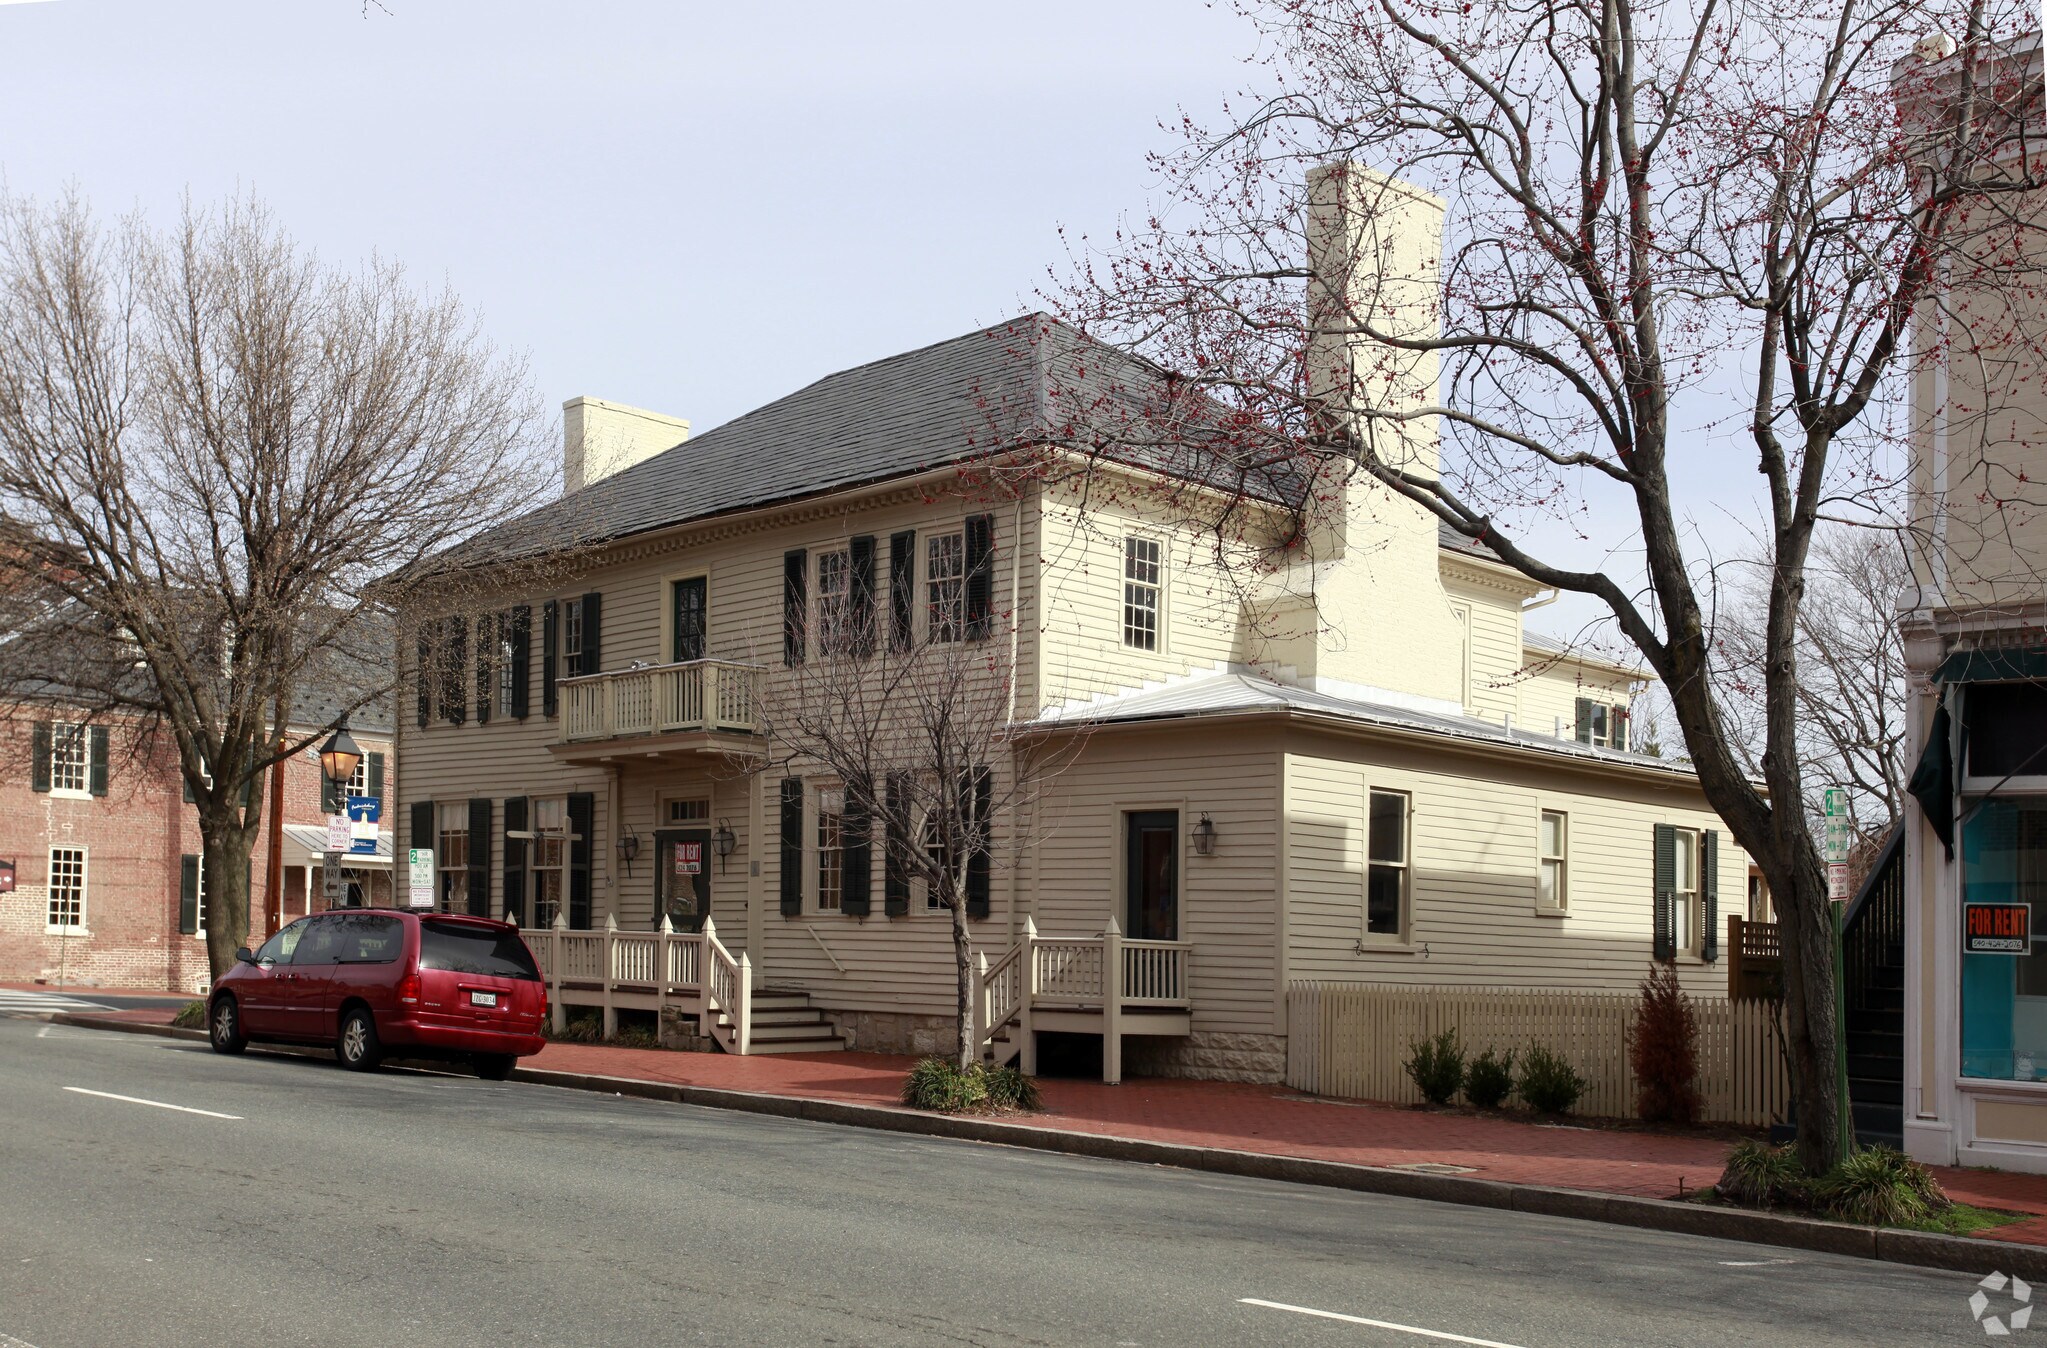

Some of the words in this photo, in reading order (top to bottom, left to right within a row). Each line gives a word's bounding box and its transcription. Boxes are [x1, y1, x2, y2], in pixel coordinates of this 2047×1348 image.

[411, 852, 417, 862] 2
[686, 844, 699, 860] RENT
[325, 855, 338, 866] ONE
[325, 869, 338, 879] WAY
[1969, 908, 1992, 935] FOR
[1995, 908, 2027, 936] RENT
